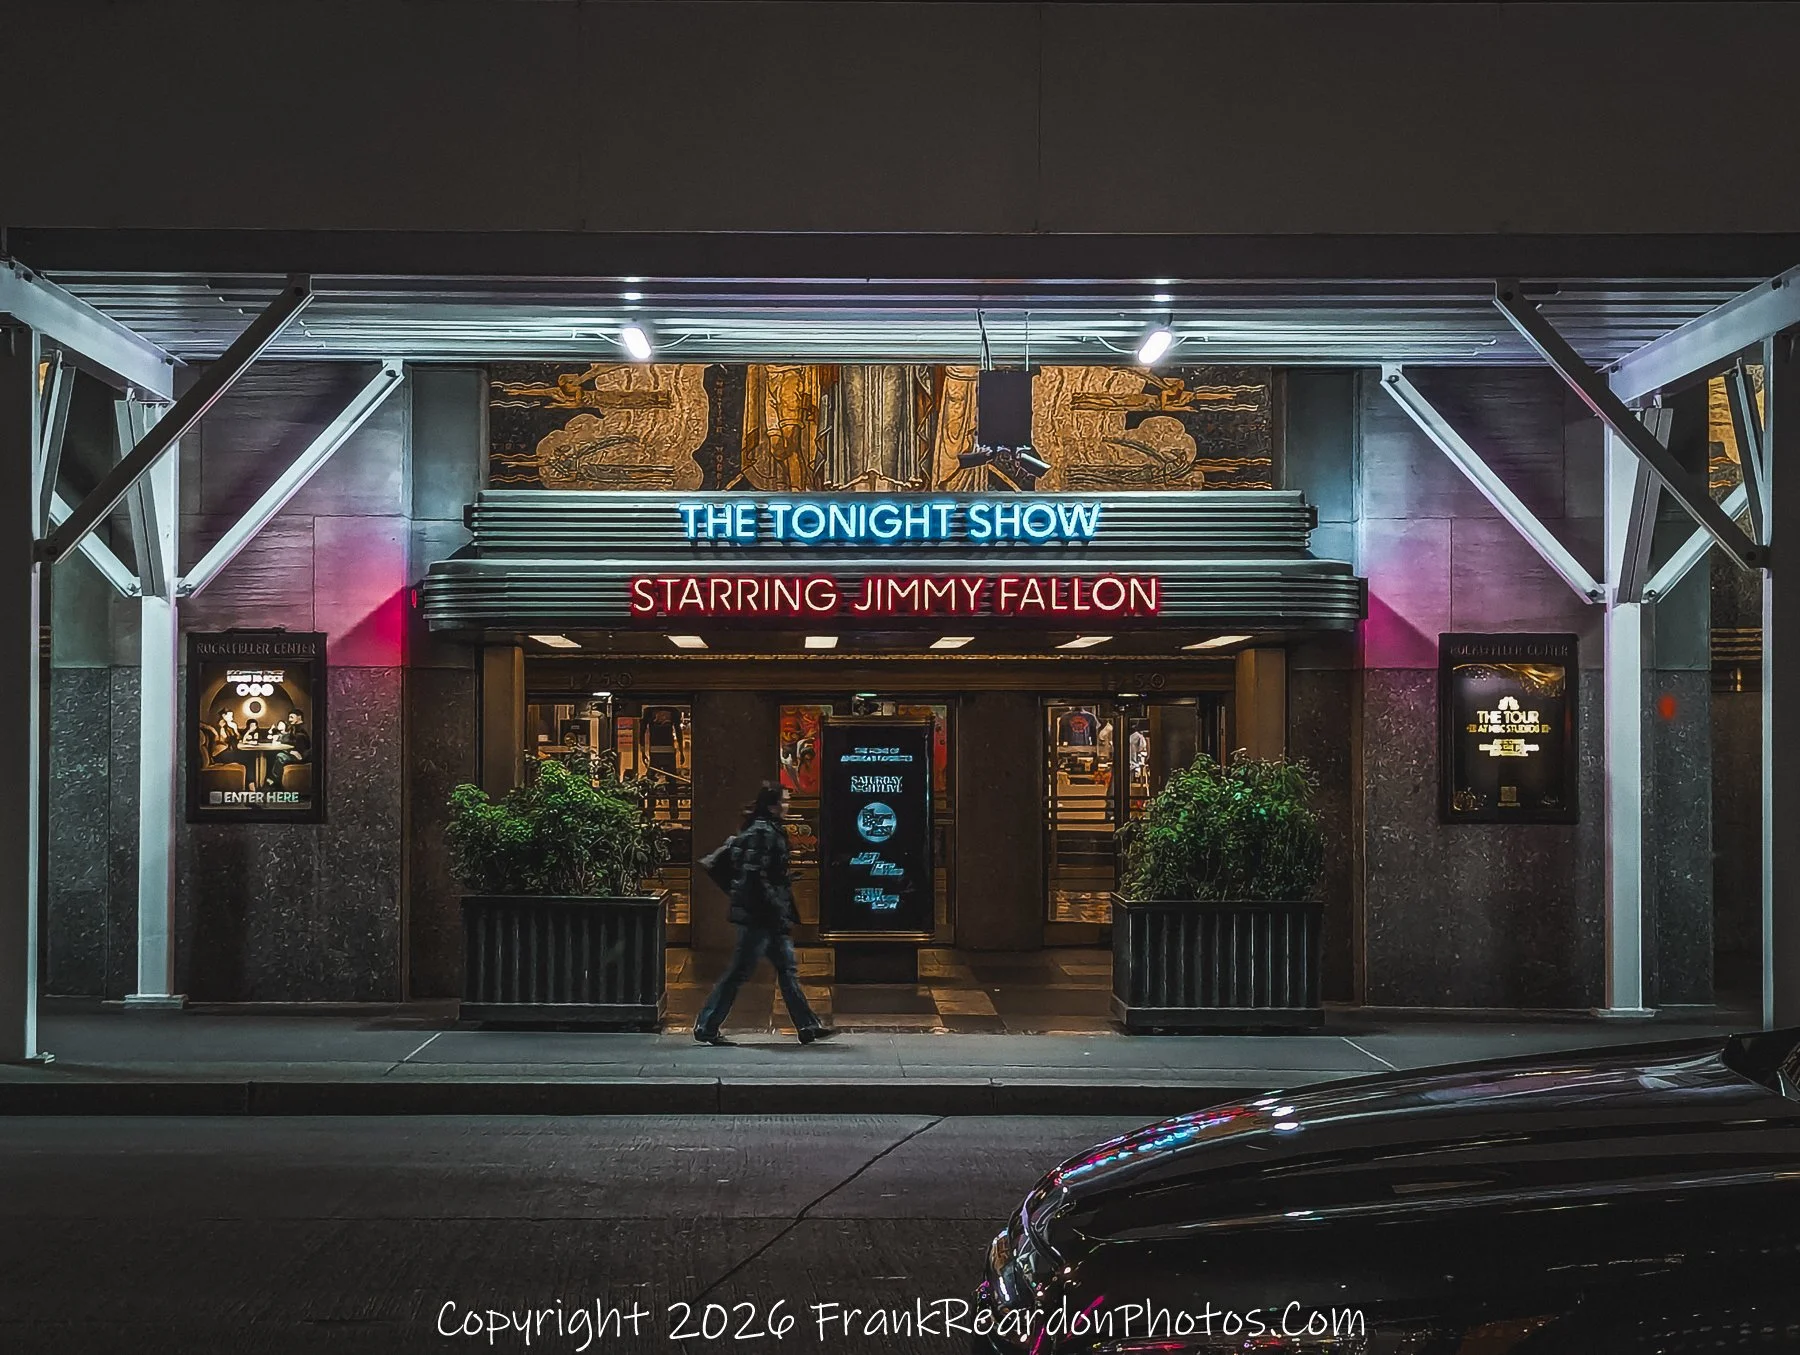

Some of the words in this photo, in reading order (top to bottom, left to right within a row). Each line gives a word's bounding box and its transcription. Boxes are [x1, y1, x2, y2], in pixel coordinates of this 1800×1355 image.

[678, 504, 755, 538] THE
[767, 504, 957, 538] TONIGHT
[969, 504, 1100, 538] SHOW
[633, 578, 837, 611] STARRING
[855, 578, 984, 611] JIMMY
[1000, 578, 1156, 611] FALLON
[274, 643, 316, 655] CENTER
[1477, 711, 1502, 724] THE
[1503, 711, 1540, 724] TOUR
[850, 776, 903, 785] SATURDAY
[224, 791, 264, 803] ENTER
[266, 791, 299, 803] HERE
